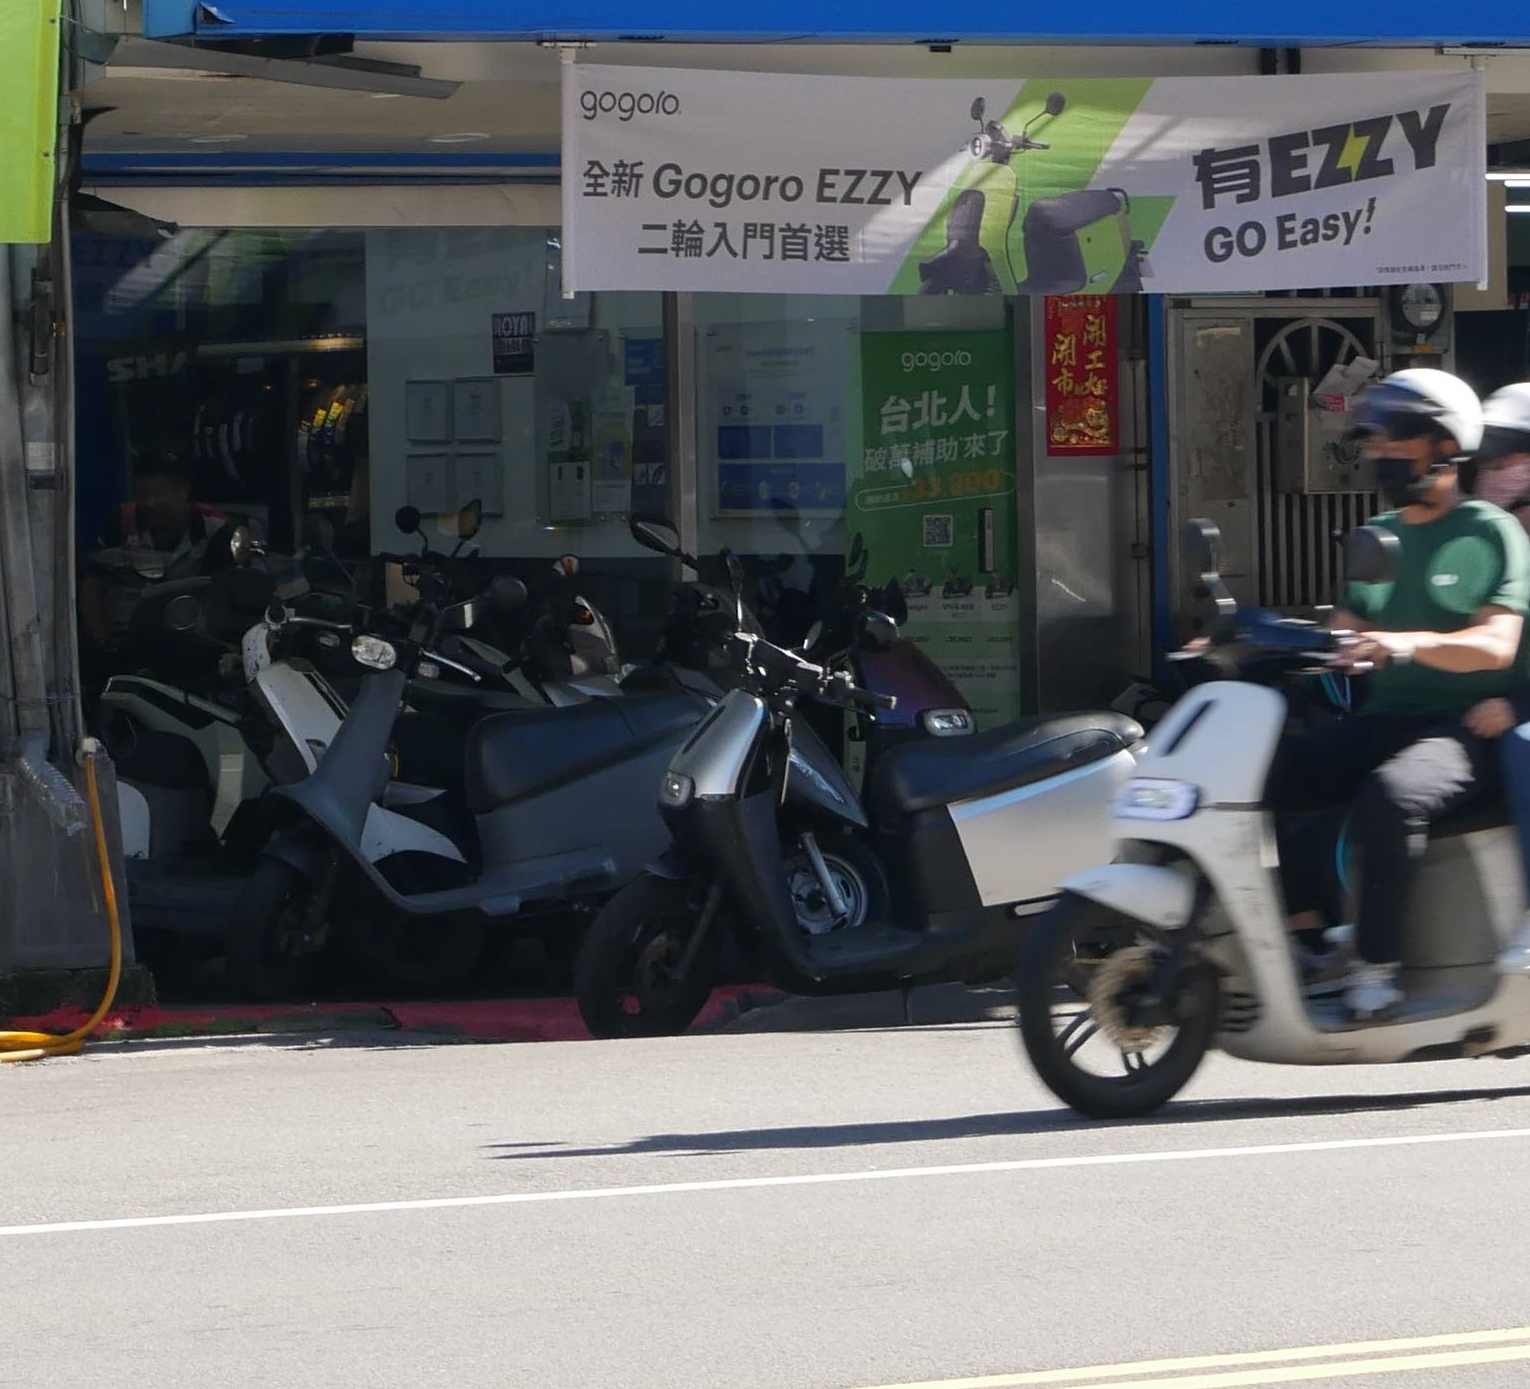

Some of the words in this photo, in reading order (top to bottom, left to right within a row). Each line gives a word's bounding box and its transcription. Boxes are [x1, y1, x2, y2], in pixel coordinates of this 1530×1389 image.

[580, 90, 679, 121] gogoro
[582, 160, 644, 198] 全新
[652, 163, 804, 207] Gogoro
[815, 169, 924, 206] EZZY
[638, 220, 851, 263] 二輪入門首選
[1203, 225, 1267, 263] GO
[1276, 197, 1378, 250] Easy!
[901, 350, 971, 372] gogoro
[879, 385, 996, 435] 台北人!
